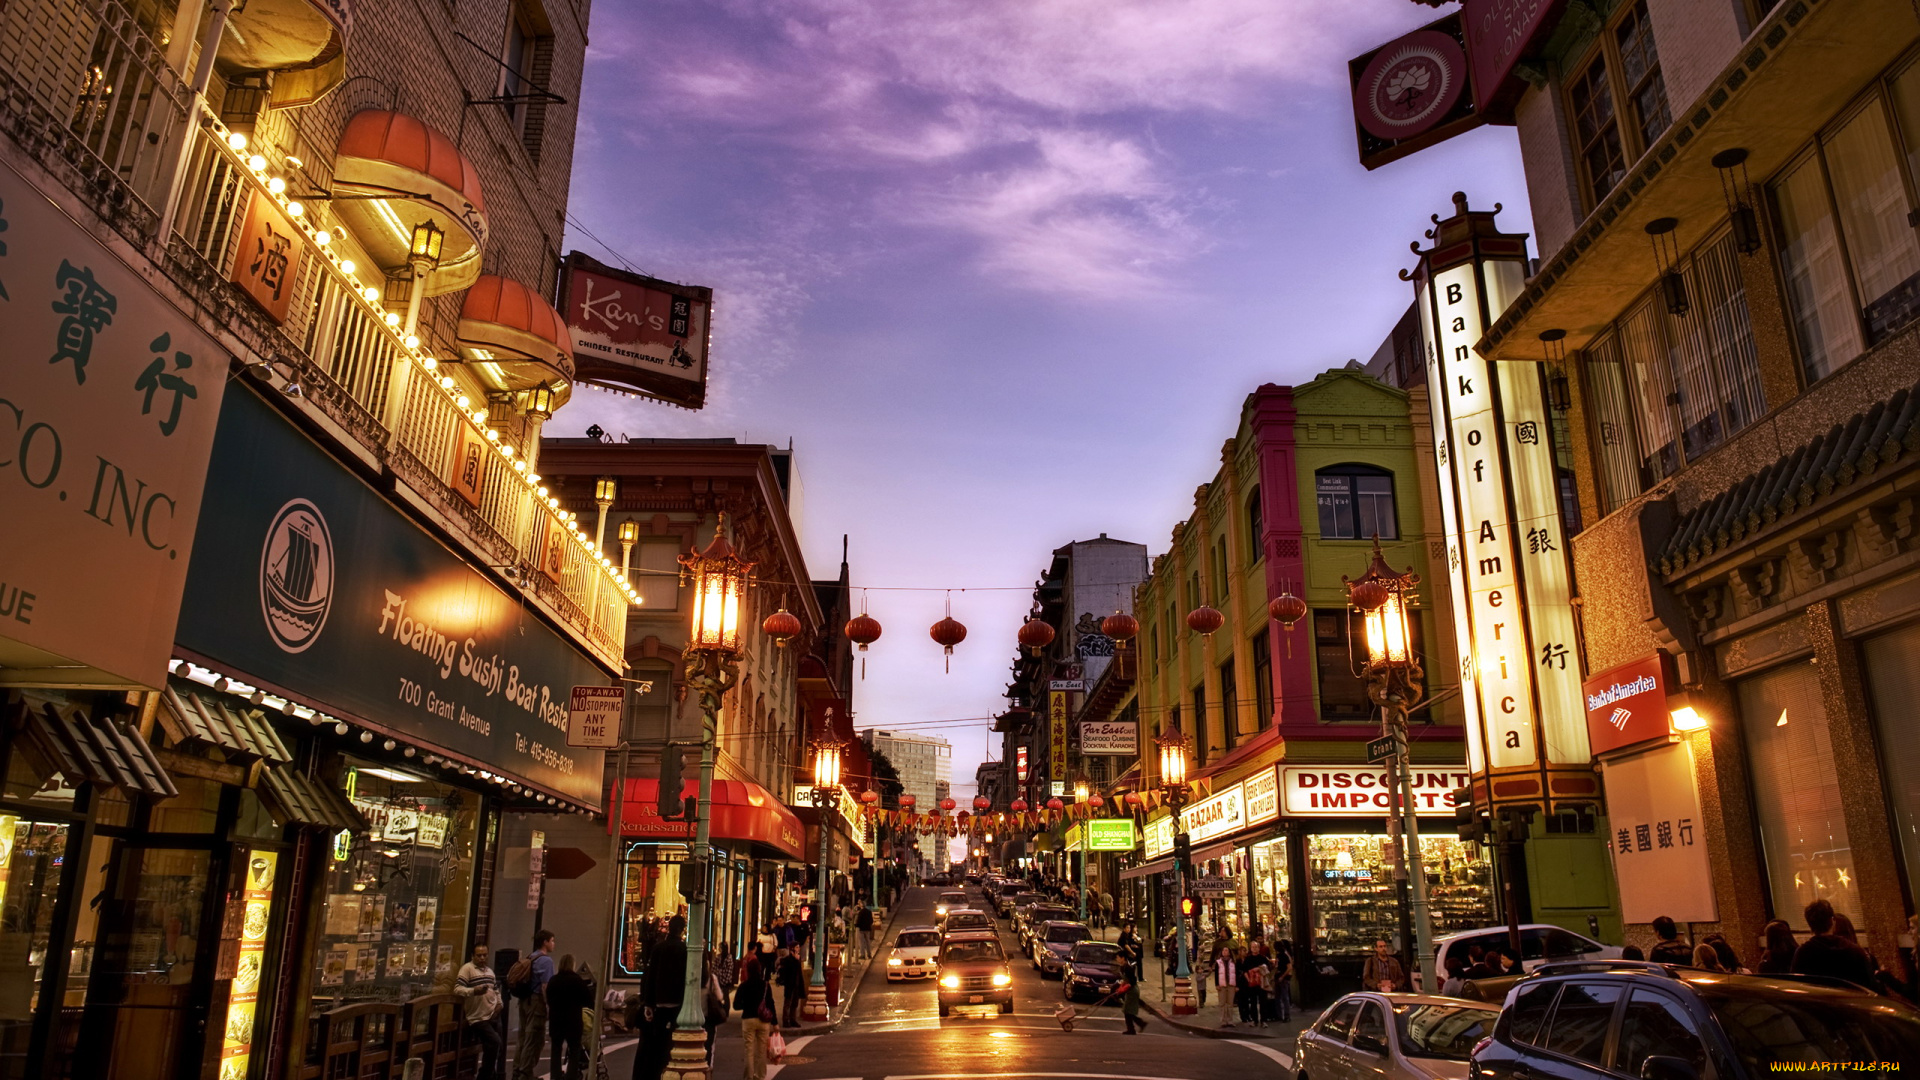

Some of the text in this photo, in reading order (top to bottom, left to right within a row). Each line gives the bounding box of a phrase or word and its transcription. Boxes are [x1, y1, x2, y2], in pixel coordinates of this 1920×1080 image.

[250, 221, 291, 301] 酒
[580, 278, 664, 332] Kan's
[578, 340, 664, 365] CHINESE RESTAURANT
[83, 455, 178, 561] INC.
[1446, 282, 1521, 749] Bank of America
[378, 588, 457, 680] Floating
[459, 637, 505, 697] Sushi
[505, 665, 538, 714] Boat
[572, 697, 621, 711] NO STOPPING
[576, 688, 621, 696] TOW-AWAY
[398, 677, 491, 737] 700 Grant Avenue
[585, 714, 606, 724] ANY
[583, 726, 605, 737] TIME
[1082, 723, 1100, 735] Far
[1101, 724, 1125, 735] East
[515, 732, 574, 775] Tel: 415-956-8318
[1372, 740, 1393, 757] Grant
[1190, 801, 1224, 830] BAZAAR
[1617, 818, 1694, 855] 美國銀行
[1190, 881, 1233, 889] SACRAMENTO
